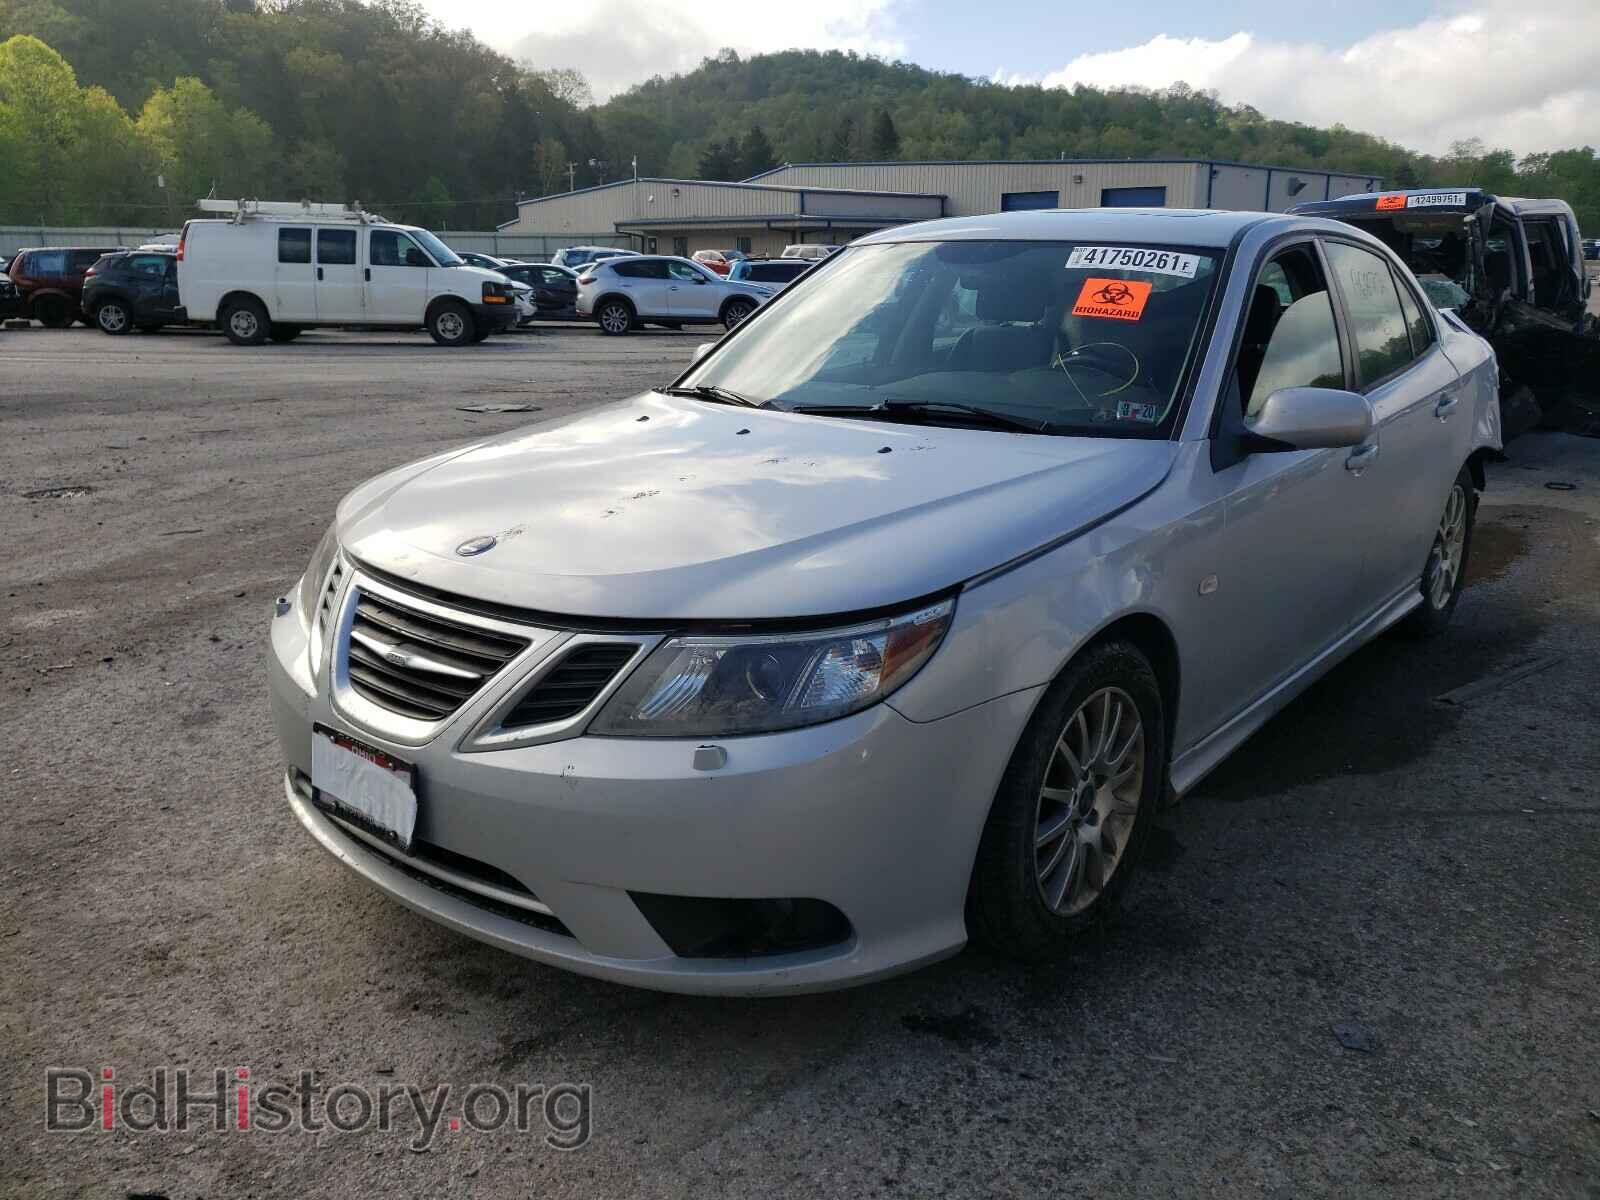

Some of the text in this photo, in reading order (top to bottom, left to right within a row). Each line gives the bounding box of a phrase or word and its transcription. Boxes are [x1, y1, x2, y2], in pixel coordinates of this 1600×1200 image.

[1084, 248, 1190, 271] 41750261 F
[1075, 305, 1140, 318] BIOHAZARD
